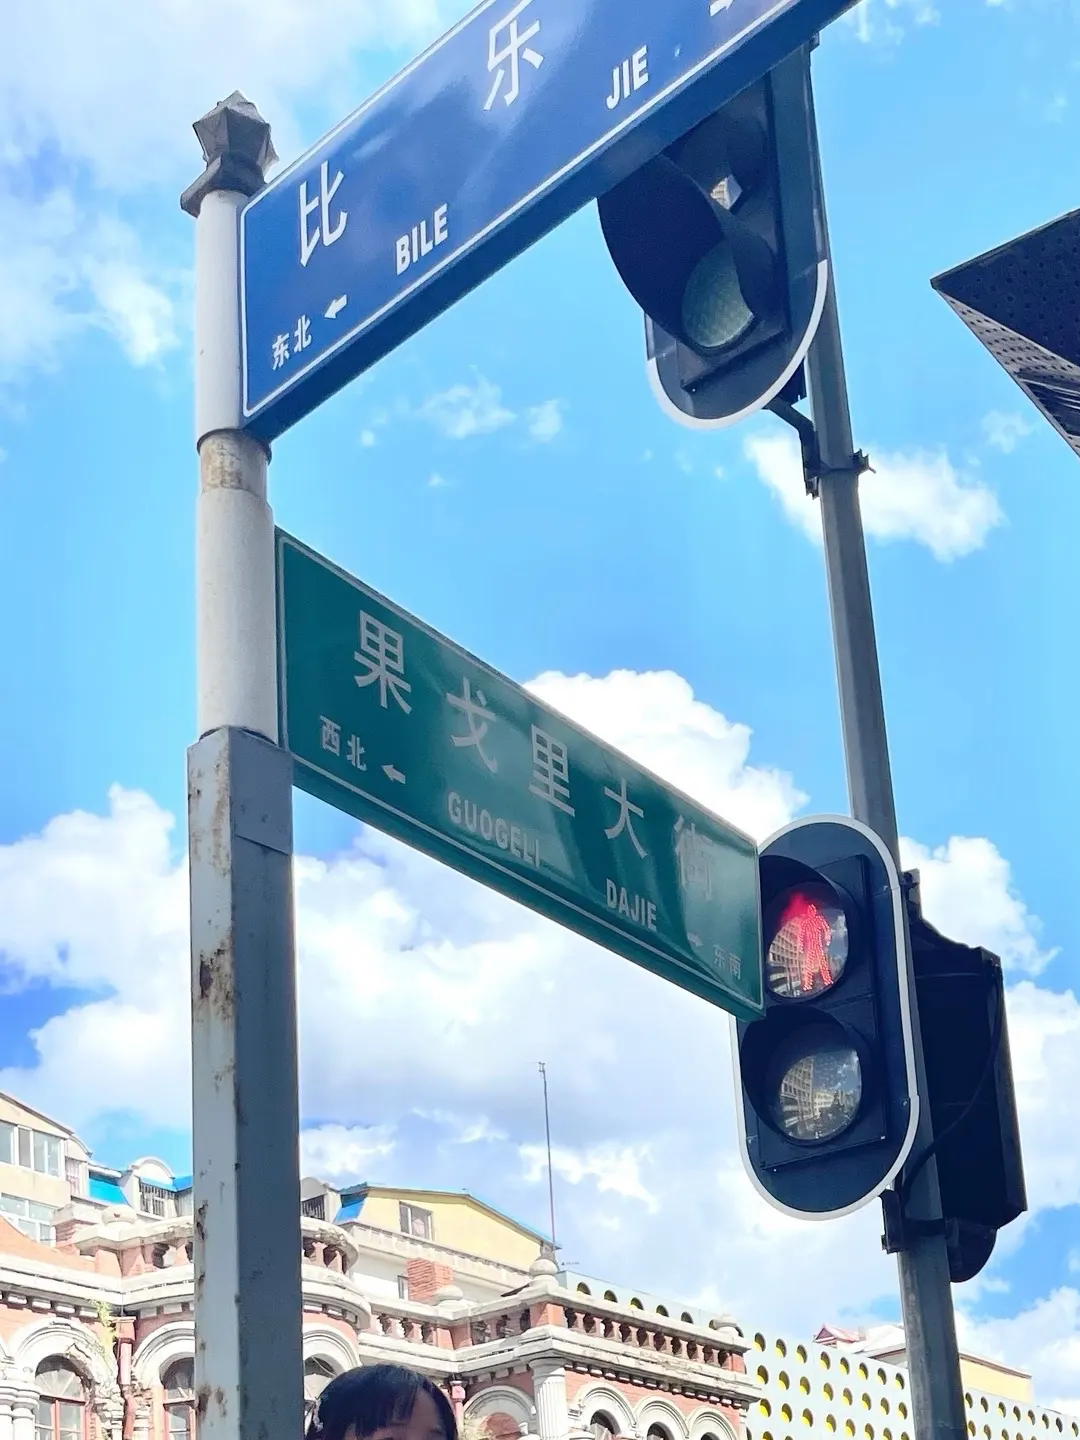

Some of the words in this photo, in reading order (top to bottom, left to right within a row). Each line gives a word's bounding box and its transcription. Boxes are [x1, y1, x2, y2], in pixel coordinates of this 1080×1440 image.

[395, 203, 449, 276] BILE
[606, 45, 650, 111] JIE
[271, 318, 312, 371] 东北
[319, 715, 367, 772] 西北
[353, 610, 717, 902] 果戈里大街
[447, 791, 541, 870] GUOGELI
[605, 878, 658, 932] DAJIE
[712, 943, 742, 981] 东南
